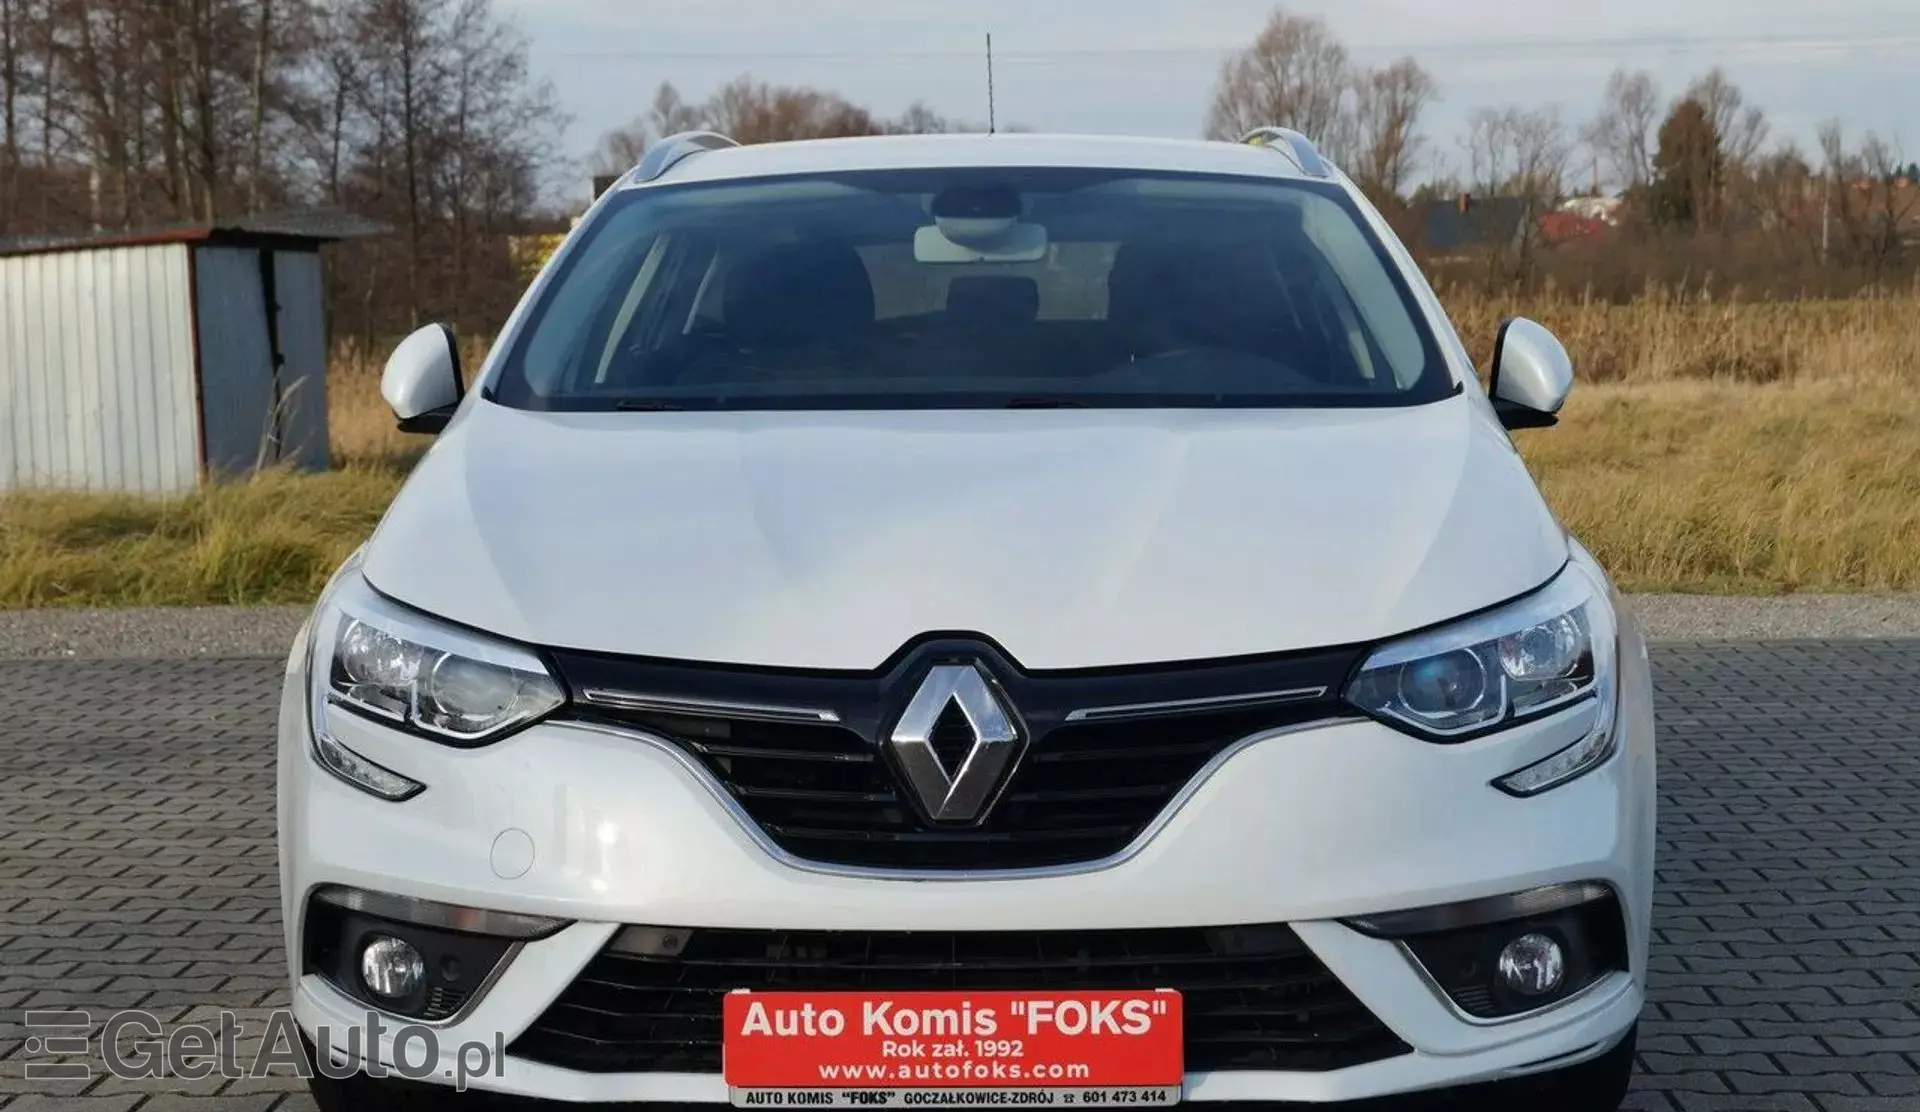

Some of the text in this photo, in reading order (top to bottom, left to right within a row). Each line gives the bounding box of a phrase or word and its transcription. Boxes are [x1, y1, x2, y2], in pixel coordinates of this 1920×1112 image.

[741, 999, 1167, 1038] Auto Komis "FOKS"
[881, 1040, 1024, 1058] Rok zał. 1992
[819, 1060, 1090, 1080] www.autofoks.com
[746, 1091, 783, 1105] AUTO
[787, 1091, 834, 1105] KOMIS
[904, 1090, 1055, 1105] GOCZAŁKOWICE-ZDRÓJ
[1082, 1091, 1107, 1104] 601
[1111, 1091, 1138, 1104] 473
[1142, 1090, 1167, 1104] 414
